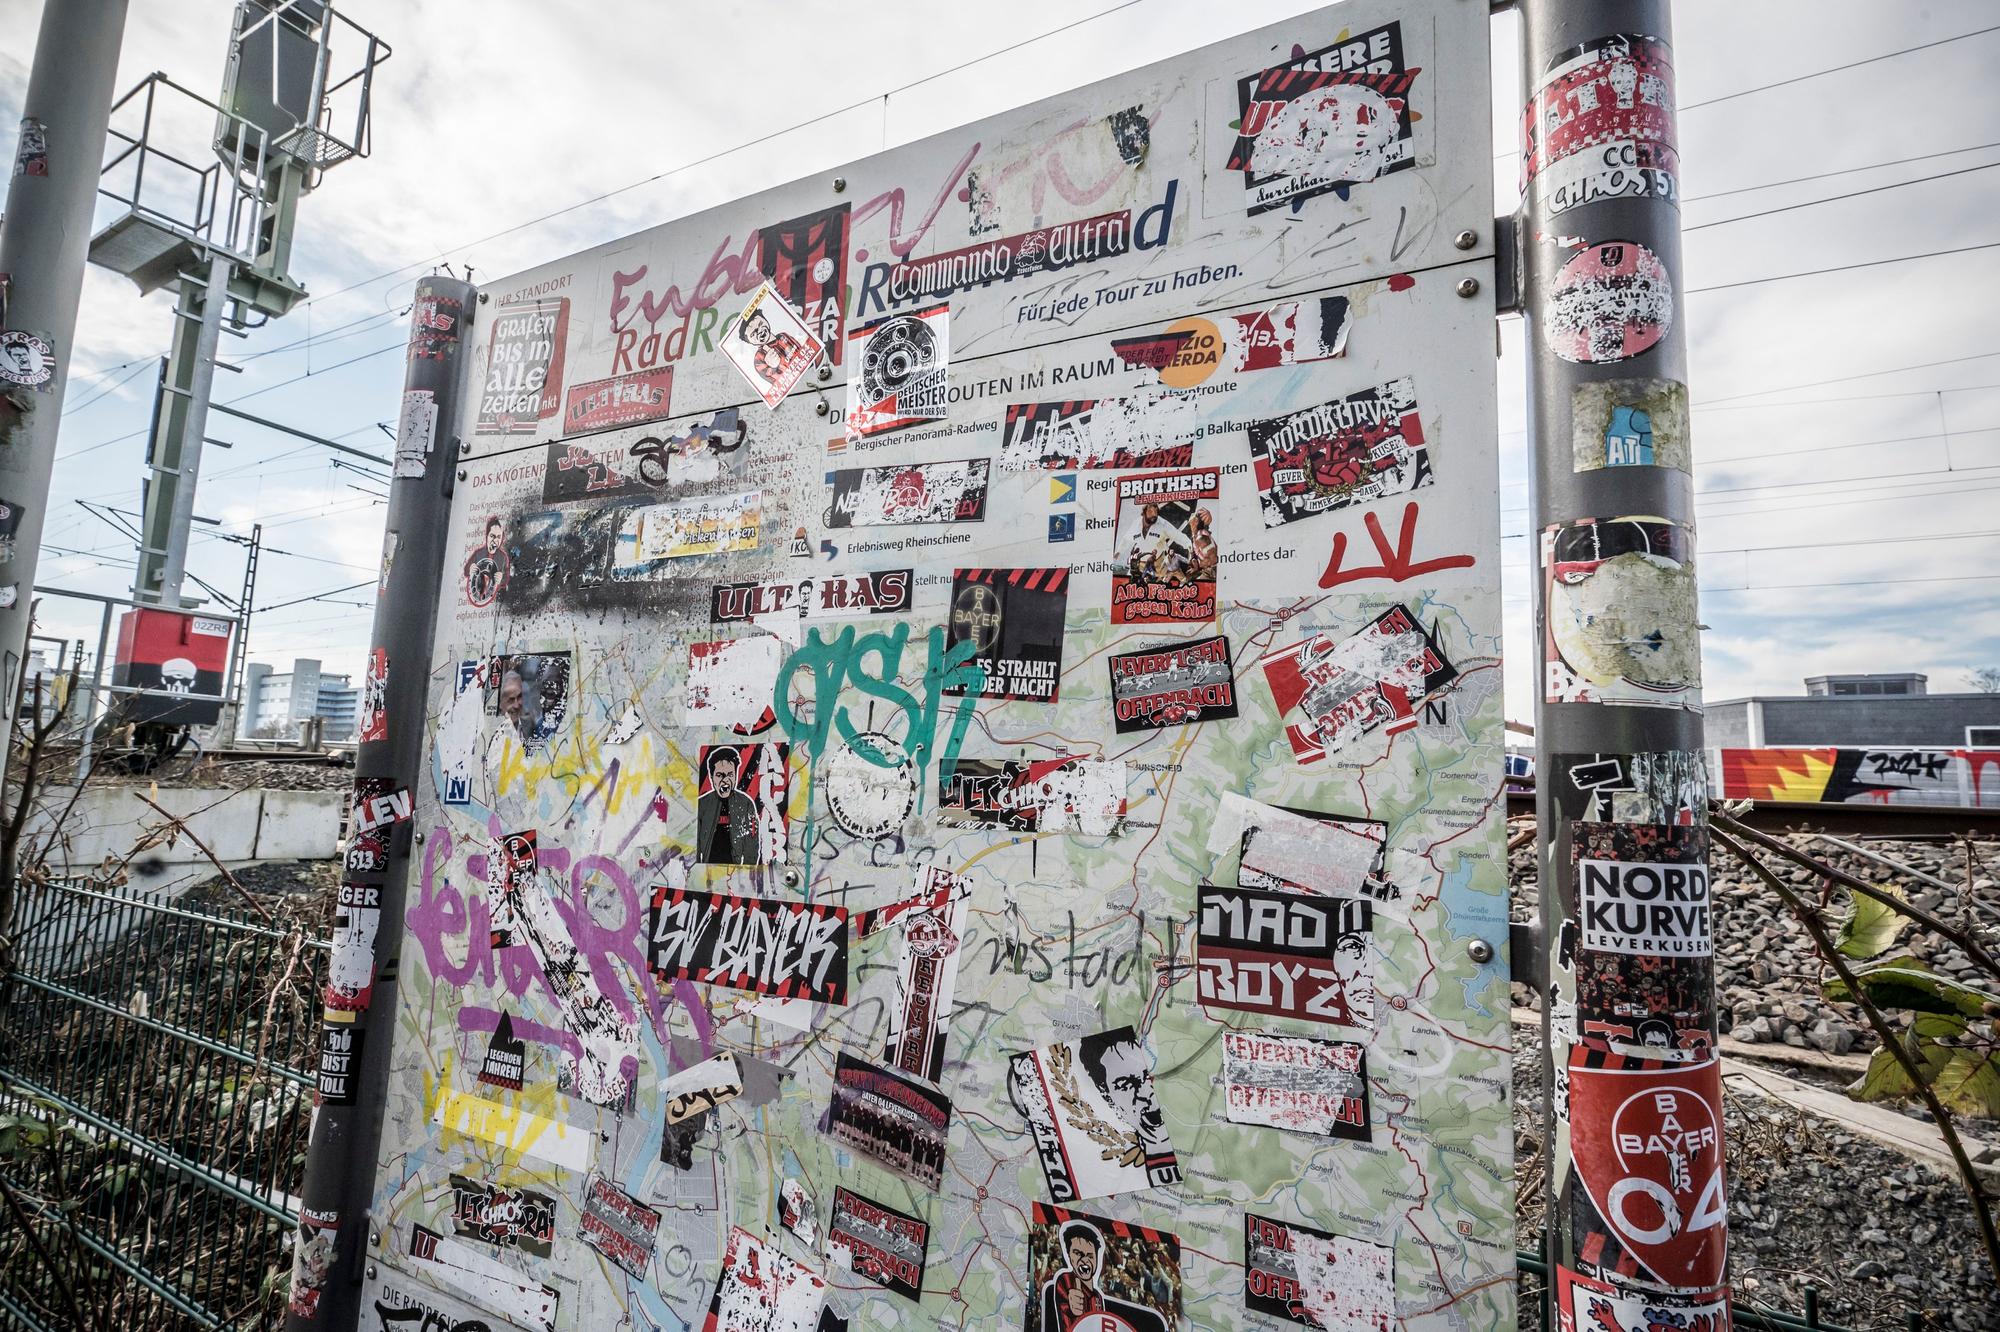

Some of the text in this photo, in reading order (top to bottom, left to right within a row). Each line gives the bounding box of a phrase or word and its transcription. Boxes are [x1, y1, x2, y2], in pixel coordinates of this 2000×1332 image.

[891, 243, 1011, 299] Commando
[494, 273, 574, 310] IHR STANDORT
[1018, 262, 1244, 324] Für jede Tour zu haben.
[486, 362, 545, 392] alle
[897, 368, 946, 399] DEUTSCHER
[829, 408, 846, 425] DI
[948, 375, 1012, 405] OUTEN
[1019, 371, 1045, 389] IM
[1052, 358, 1114, 386] RAUM
[897, 385, 946, 409] MEISTER
[925, 407, 935, 416] DER
[936, 406, 947, 416] SVB
[855, 420, 998, 452] Bergischer Panorama-Radweg
[1265, 399, 1399, 466] NORDKURVE
[472, 474, 493, 488] DAS
[1119, 473, 1216, 498] BROTHERS
[1276, 469, 1303, 484] LEVER
[1134, 490, 1200, 505] LEVERKUSEN
[1359, 483, 1381, 496] DABEI
[847, 532, 971, 555] Erlebnisweg Rheinschiene
[1277, 546, 1295, 561] dar
[1069, 562, 1085, 574] der
[915, 575, 938, 587] stellt
[1115, 583, 1198, 604] Alle Fäuste
[955, 608, 1000, 627] BAYER
[1125, 598, 1213, 620] gegen Köln!
[193, 620, 228, 634] 02ZR5
[997, 660, 1057, 679] STRAHLT
[1111, 637, 1226, 680] LEVERKUSEN
[1010, 678, 1056, 697] NACHT
[1115, 682, 1232, 722] OFFENBACH
[1425, 700, 1447, 726] N
[1867, 752, 1949, 780] 2024
[354, 790, 411, 835] LEV
[759, 743, 787, 866] ACAB
[349, 850, 375, 871] 513
[1585, 864, 1706, 901] NORD
[1201, 896, 1328, 947] MAD
[1586, 901, 1708, 937] KURVE
[653, 898, 717, 970] SV
[705, 903, 843, 993] BAYER
[1587, 934, 1710, 952] LEVERKUSEN
[1200, 958, 1342, 1018] BOYZ
[321, 1053, 350, 1073] BIST
[489, 1047, 522, 1065] LEGENDEN
[486, 1060, 521, 1081] JAHREN!
[319, 1075, 346, 1095] TOLL
[1619, 1127, 1715, 1155] BAYER
[481, 1200, 523, 1224] CHAOS
[1607, 1164, 1728, 1245] 04
[836, 1187, 927, 1247] LEVERKUSEN
[382, 1285, 400, 1307] DIE
